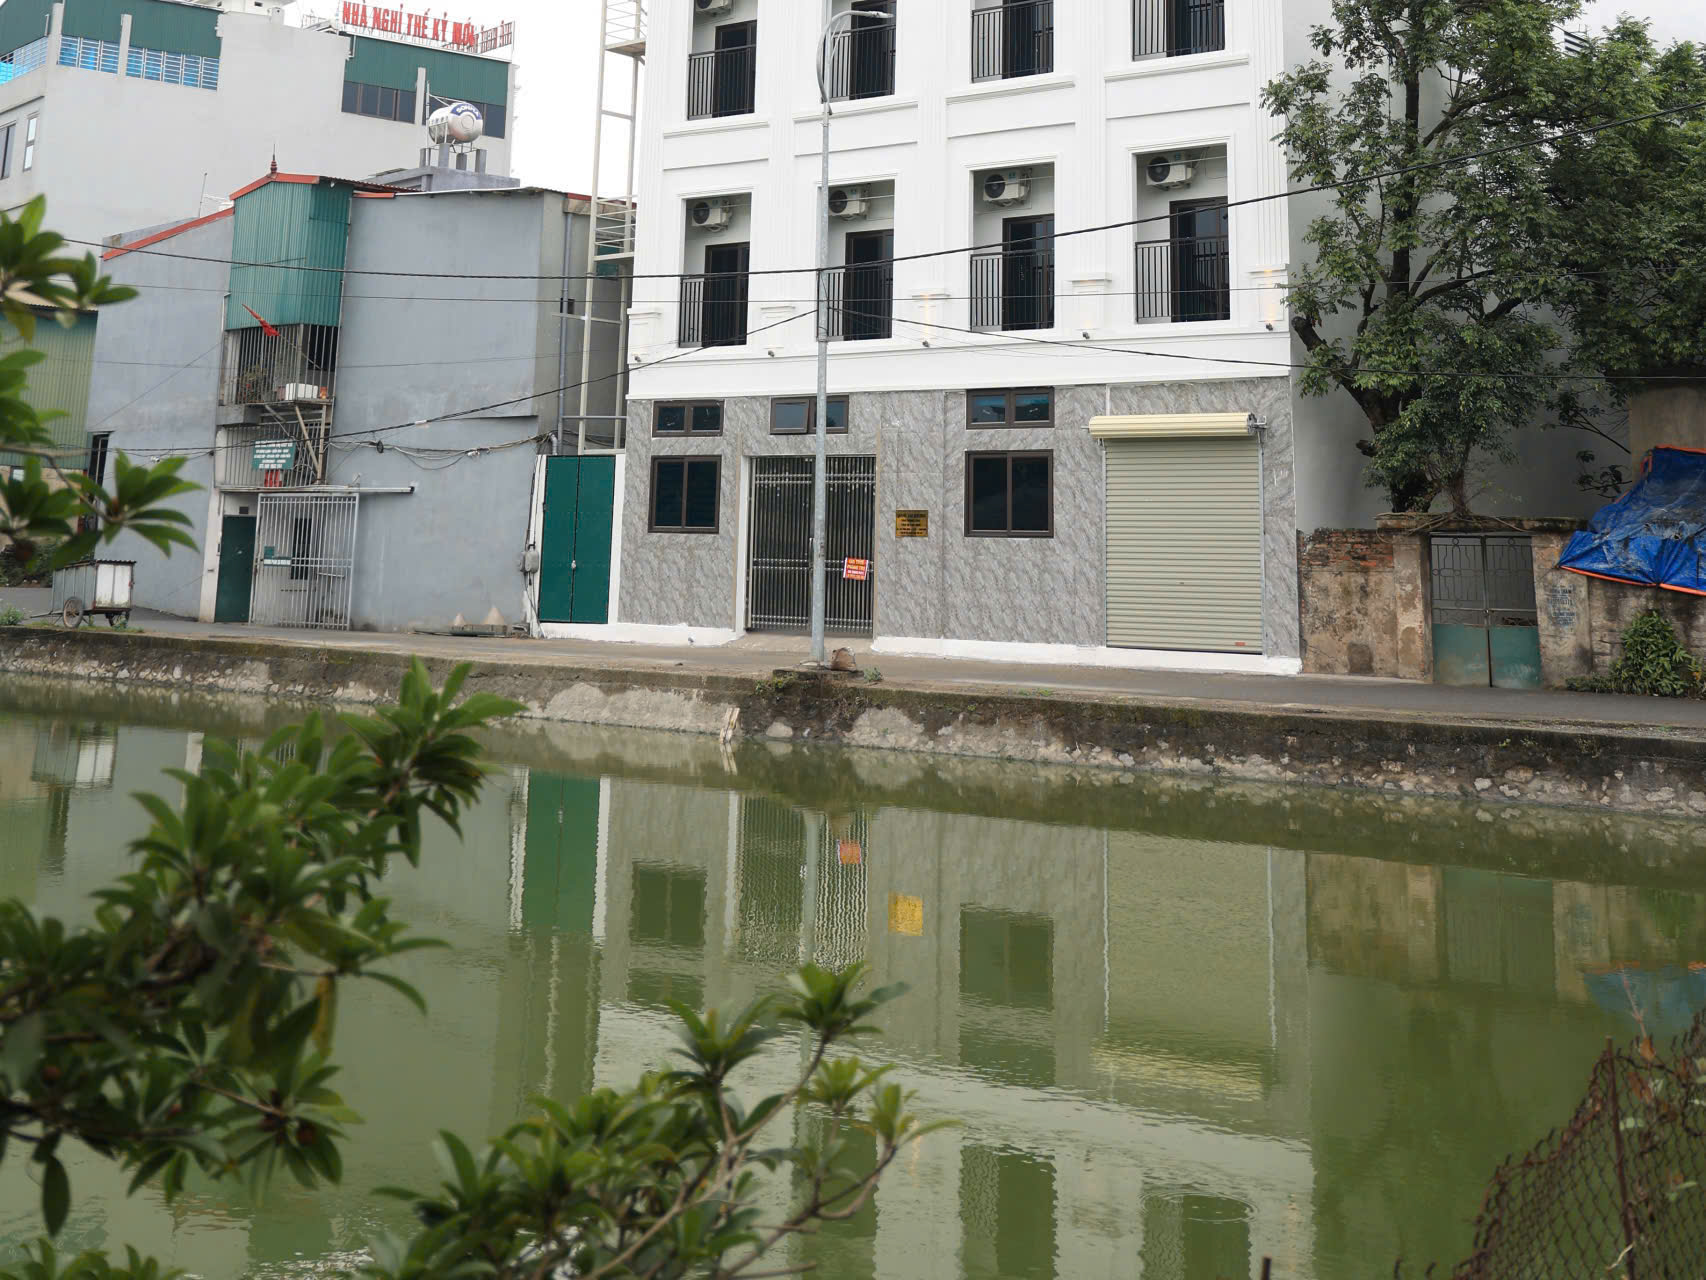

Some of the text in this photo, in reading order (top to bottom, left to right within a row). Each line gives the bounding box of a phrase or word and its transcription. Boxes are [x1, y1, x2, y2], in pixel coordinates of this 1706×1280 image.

[342, 0, 367, 28] NHÀ
[372, 4, 403, 34] NGHỈ
[406, 8, 430, 39] THẾ
